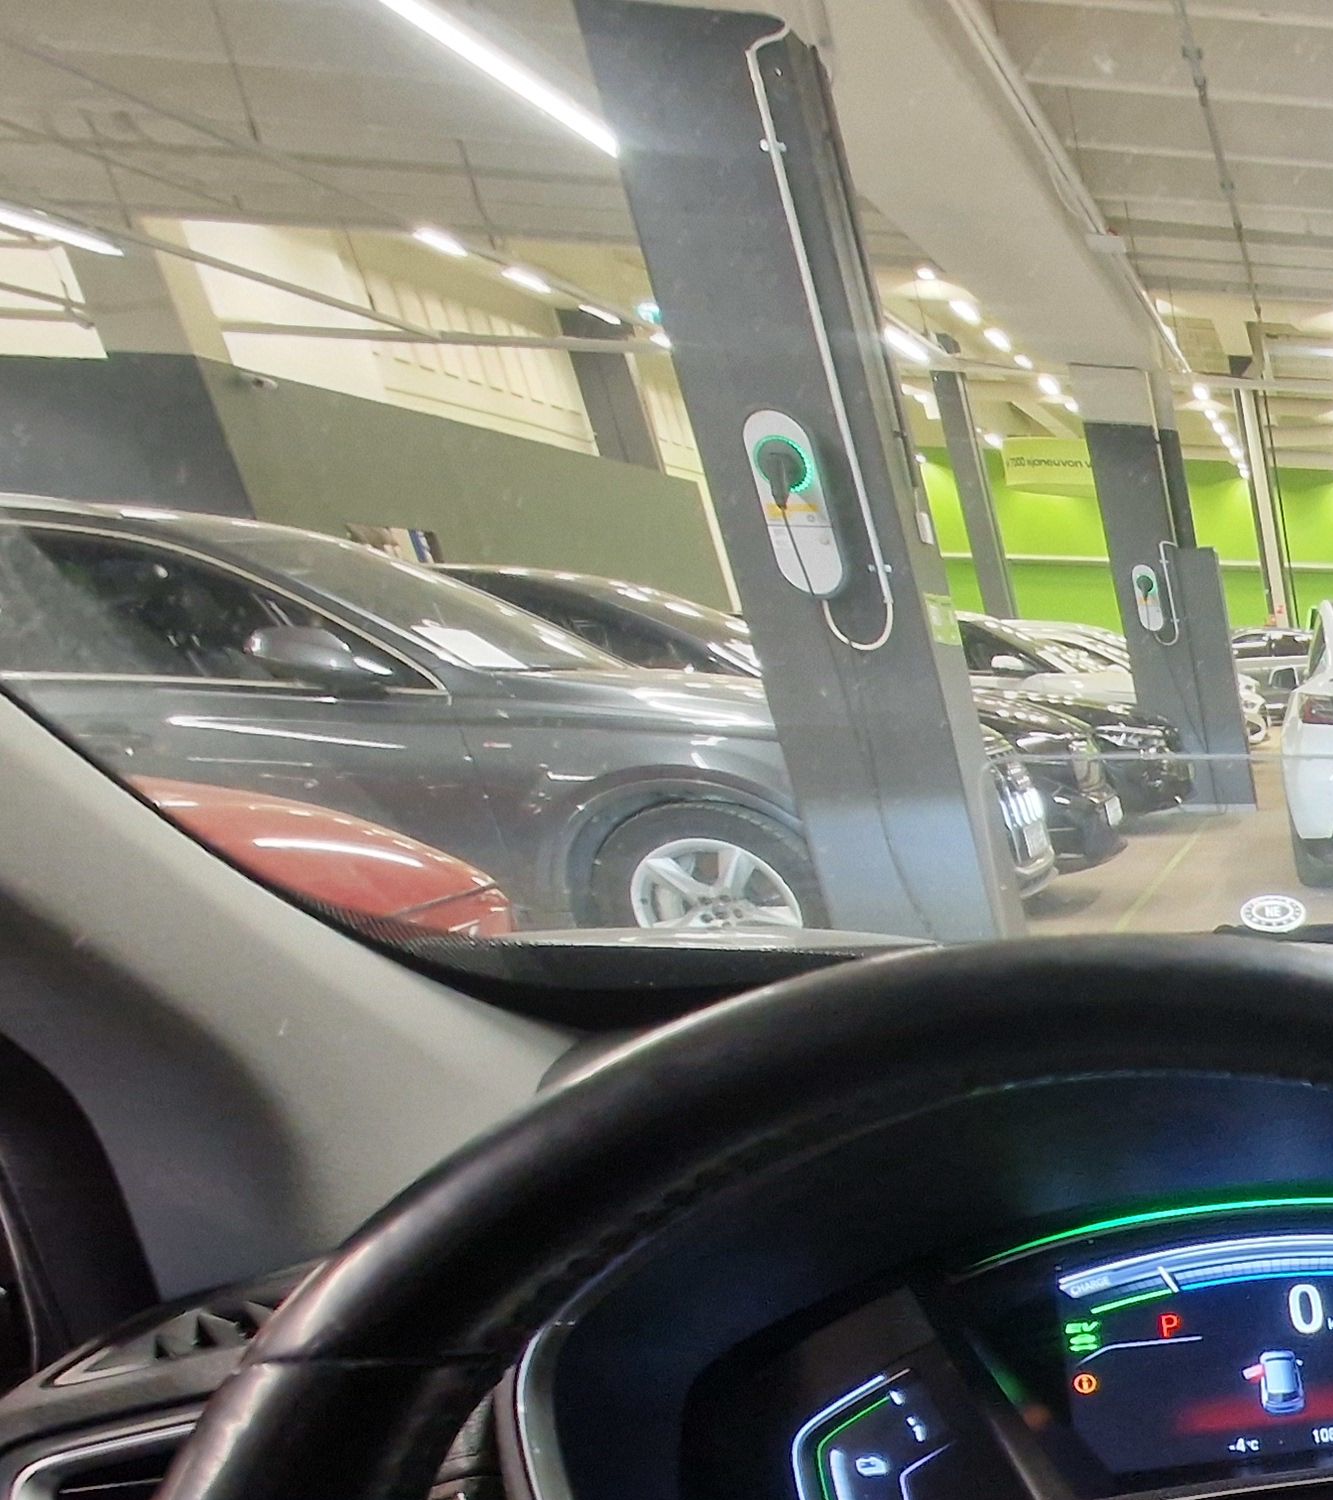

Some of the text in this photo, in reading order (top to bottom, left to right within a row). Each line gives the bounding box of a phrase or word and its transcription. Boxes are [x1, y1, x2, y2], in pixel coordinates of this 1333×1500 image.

[1069, 1275, 1112, 1296] CHARGE
[1288, 1283, 1324, 1335] 0
[1161, 1314, 1178, 1338] P
